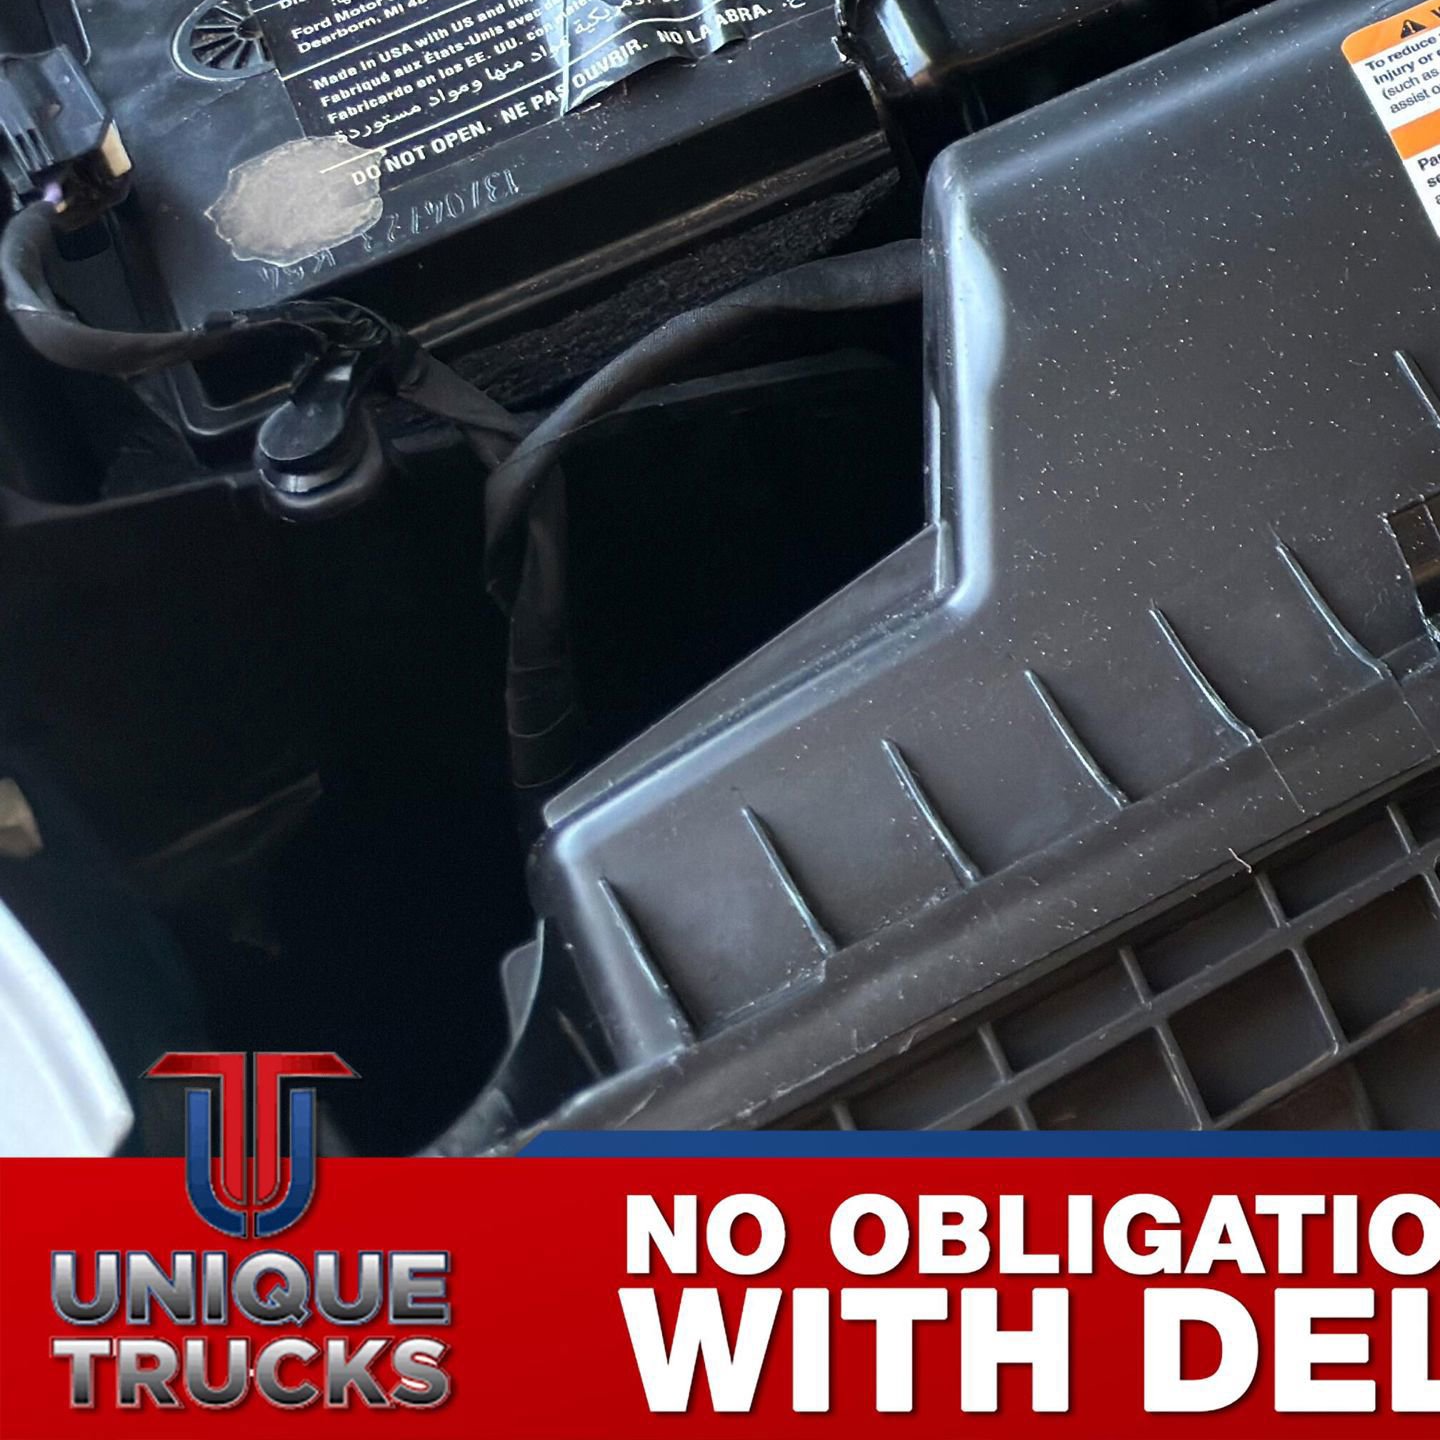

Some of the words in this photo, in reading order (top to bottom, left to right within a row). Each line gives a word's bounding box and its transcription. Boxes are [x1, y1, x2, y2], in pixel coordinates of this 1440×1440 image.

[289, 15, 333, 41] Ford
[296, 15, 383, 55] Dearborn,
[382, 2, 406, 20] MI
[311, 66, 359, 91] Made
[358, 57, 378, 72] in
[377, 41, 415, 64] USA
[413, 27, 451, 49] with
[449, 15, 476, 34] US
[475, 2, 507, 24] and
[1363, 58, 1387, 72] To
[1386, 35, 1438, 64] reduce
[1416, 51, 1435, 66] or
[1380, 75, 1422, 102] (such
[1420, 67, 1440, 83] as
[1388, 87, 1432, 115] assist
[383, 143, 427, 174] NOT
[429, 119, 493, 155] OPEN.
[499, 100, 530, 124] NE
